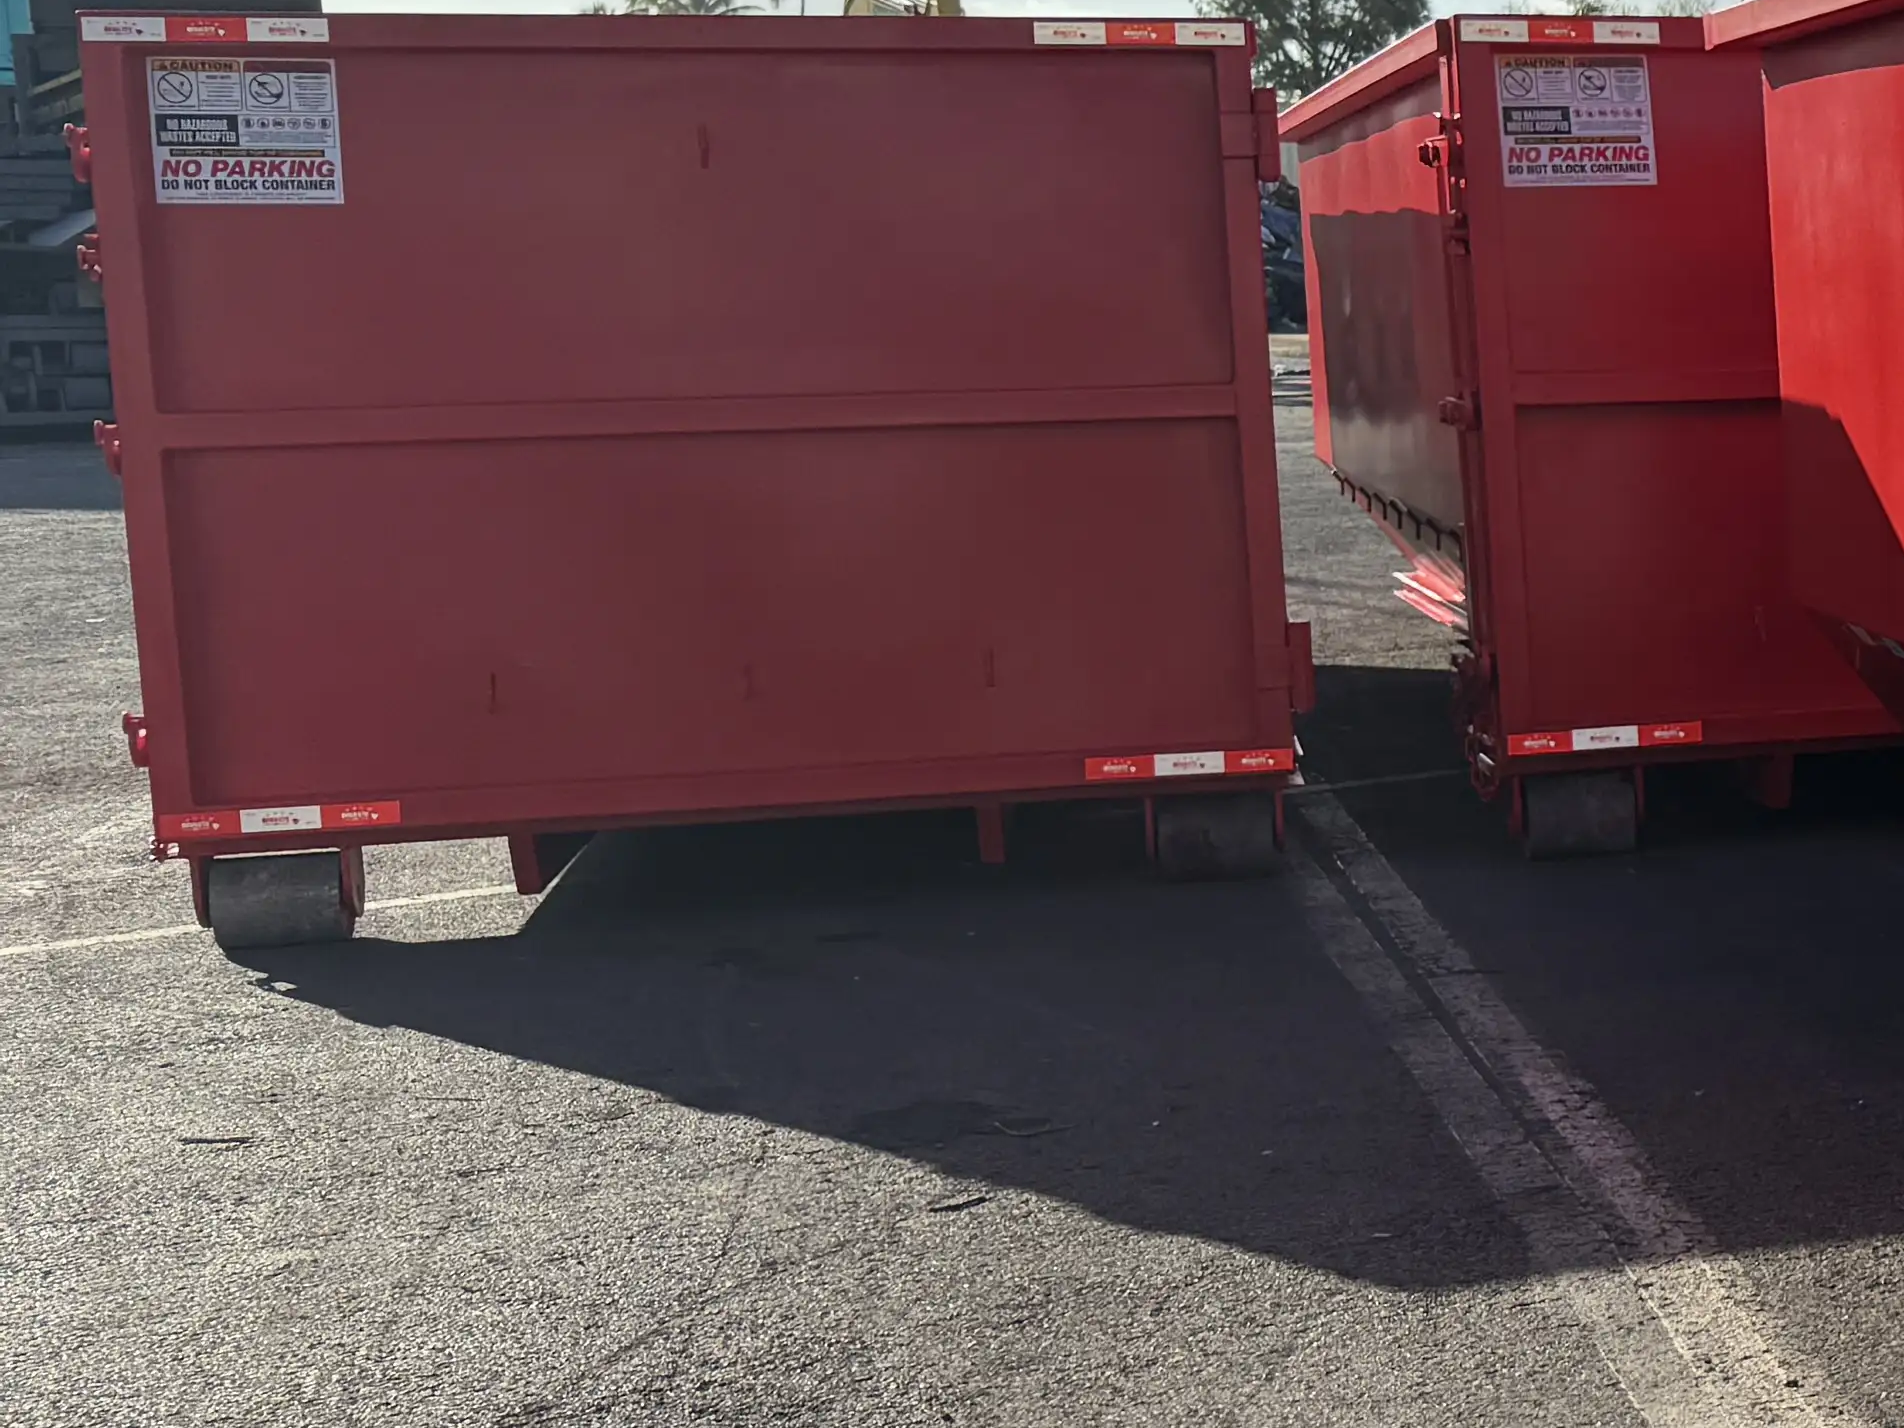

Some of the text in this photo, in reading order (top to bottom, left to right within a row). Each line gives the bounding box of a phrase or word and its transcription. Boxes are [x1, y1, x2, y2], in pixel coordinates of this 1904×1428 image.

[169, 59, 233, 72] CAUTION
[1514, 56, 1565, 68] CAUTION
[1508, 145, 1649, 163] NO PARKING
[161, 159, 336, 178] NO PARKING
[1526, 164, 1548, 175] NOT
[1551, 163, 1588, 174] BLOCK
[1590, 163, 1650, 174] CONTAINER
[162, 179, 336, 191] DO NOT BLOCK CONTAINER
